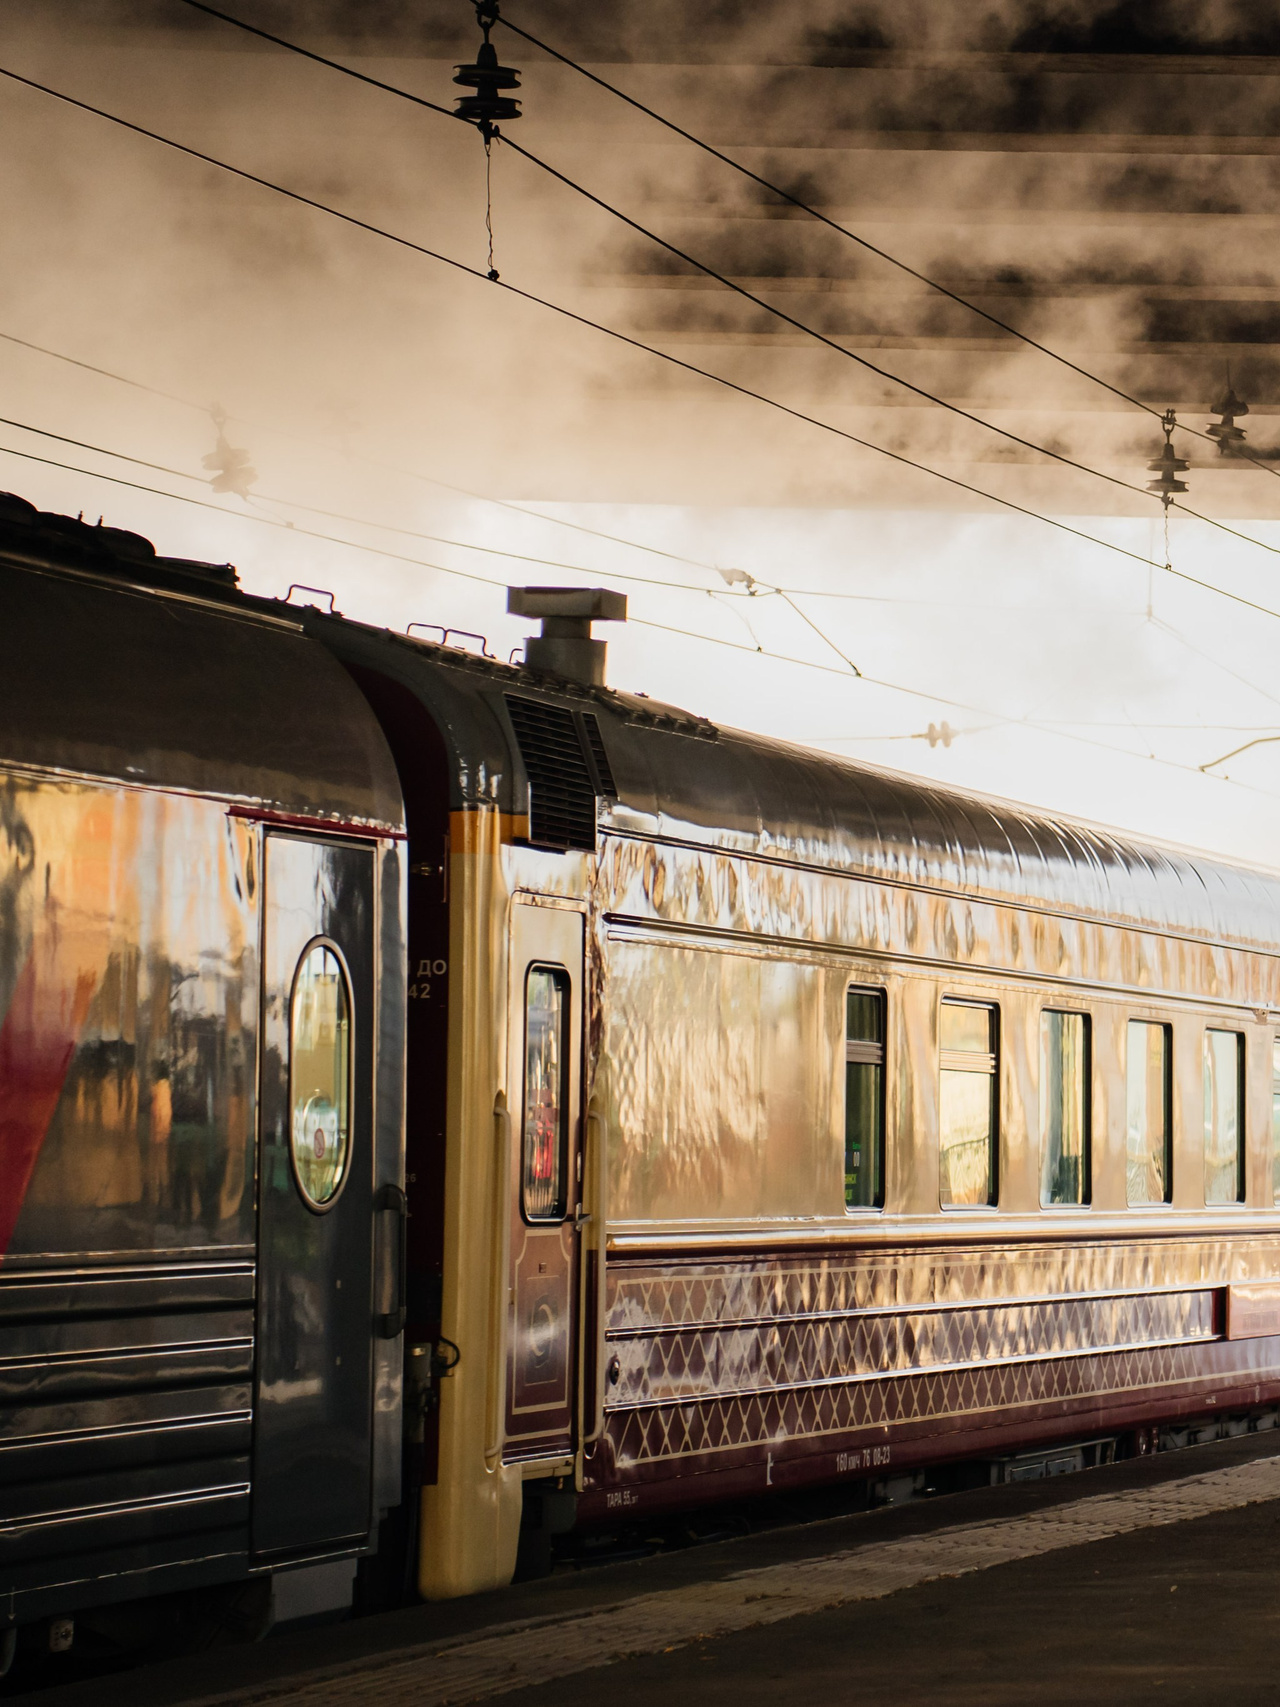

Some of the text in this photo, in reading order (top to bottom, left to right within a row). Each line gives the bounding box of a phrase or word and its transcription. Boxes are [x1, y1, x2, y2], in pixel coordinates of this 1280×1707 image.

[416, 959, 447, 978] ДО
[836, 1453, 847, 1472] 160
[863, 1449, 870, 1468] 76
[873, 1446, 890, 1466] 08-23
[606, 1492, 622, 1508] ТАРА
